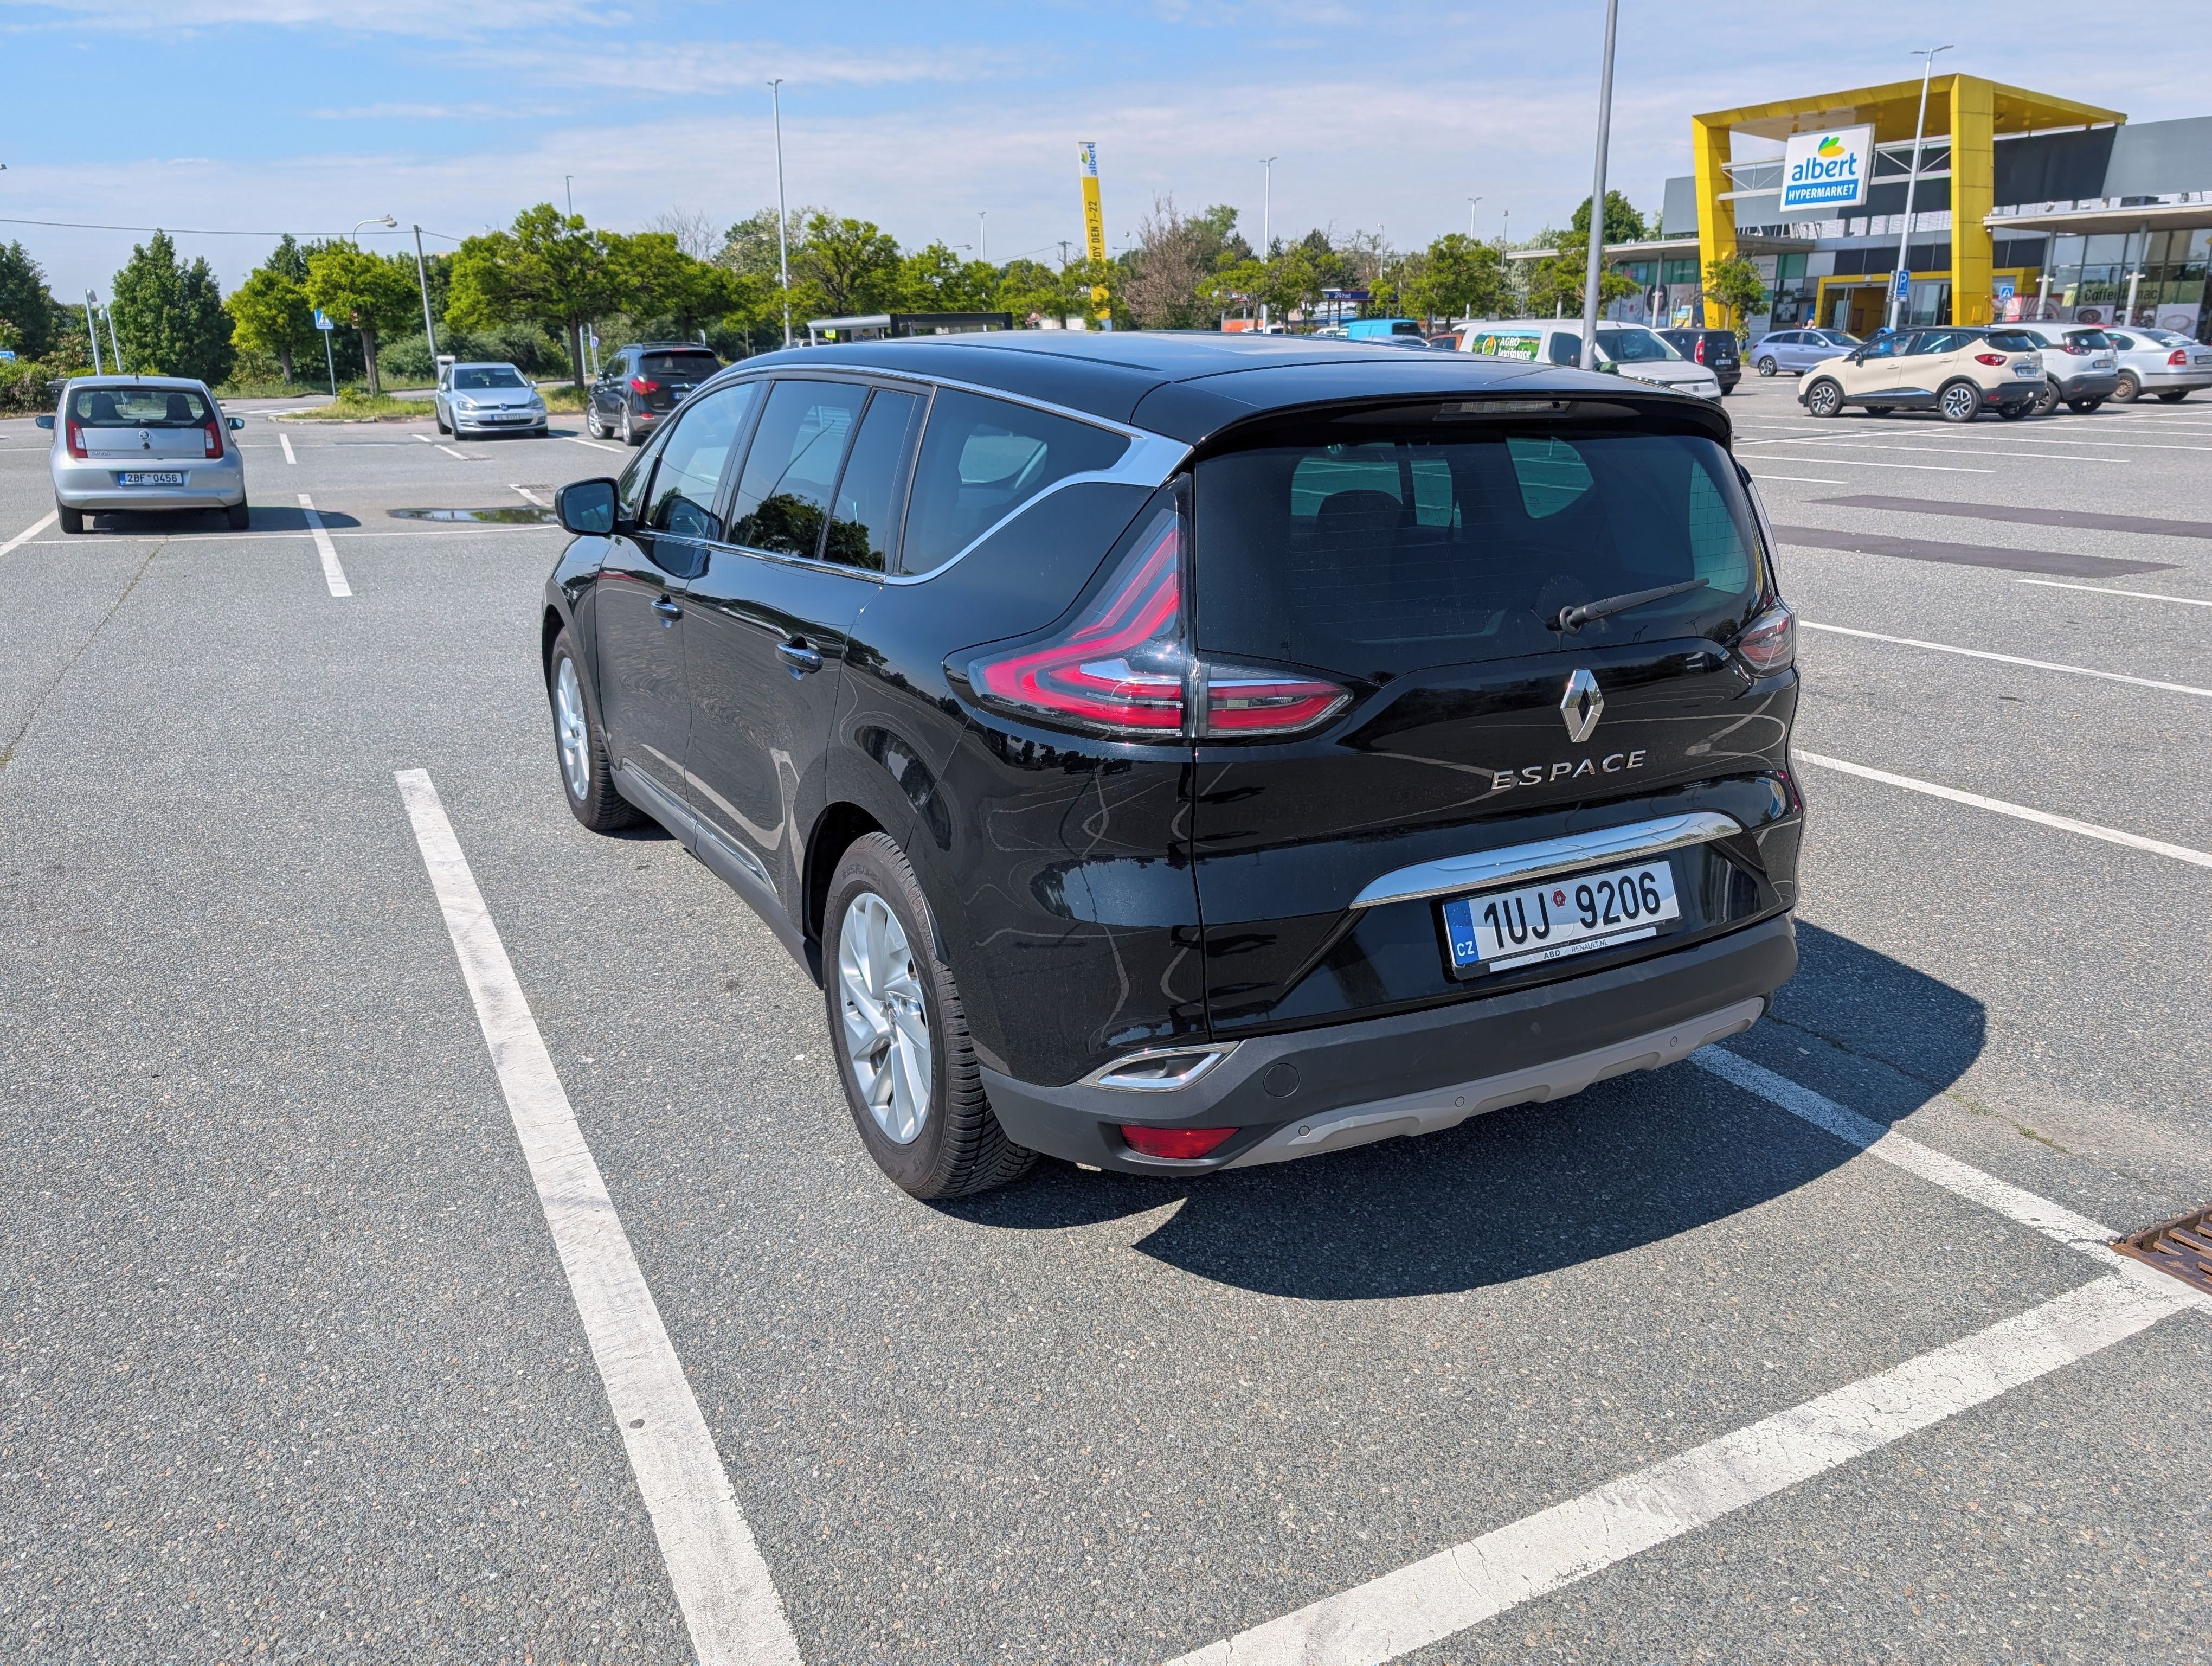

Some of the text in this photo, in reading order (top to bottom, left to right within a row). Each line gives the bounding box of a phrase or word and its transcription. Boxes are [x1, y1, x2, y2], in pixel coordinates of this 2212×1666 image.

[1086, 143, 1098, 176] albert
[1792, 152, 1857, 181] albert
[1788, 184, 1855, 201] HYPERMARKET
[1091, 226, 1101, 243] DEN
[1899, 273, 1907, 289] P
[1499, 337, 1520, 347] AGRO
[127, 474, 146, 483] 2BF
[153, 473, 178, 482] 0456
[1491, 749, 1647, 790] ESPACE
[1483, 872, 1661, 950] 1UJ 9206
[1457, 940, 1475, 957] CZ
[1544, 939, 1609, 960] ABD RENAULT.NL
